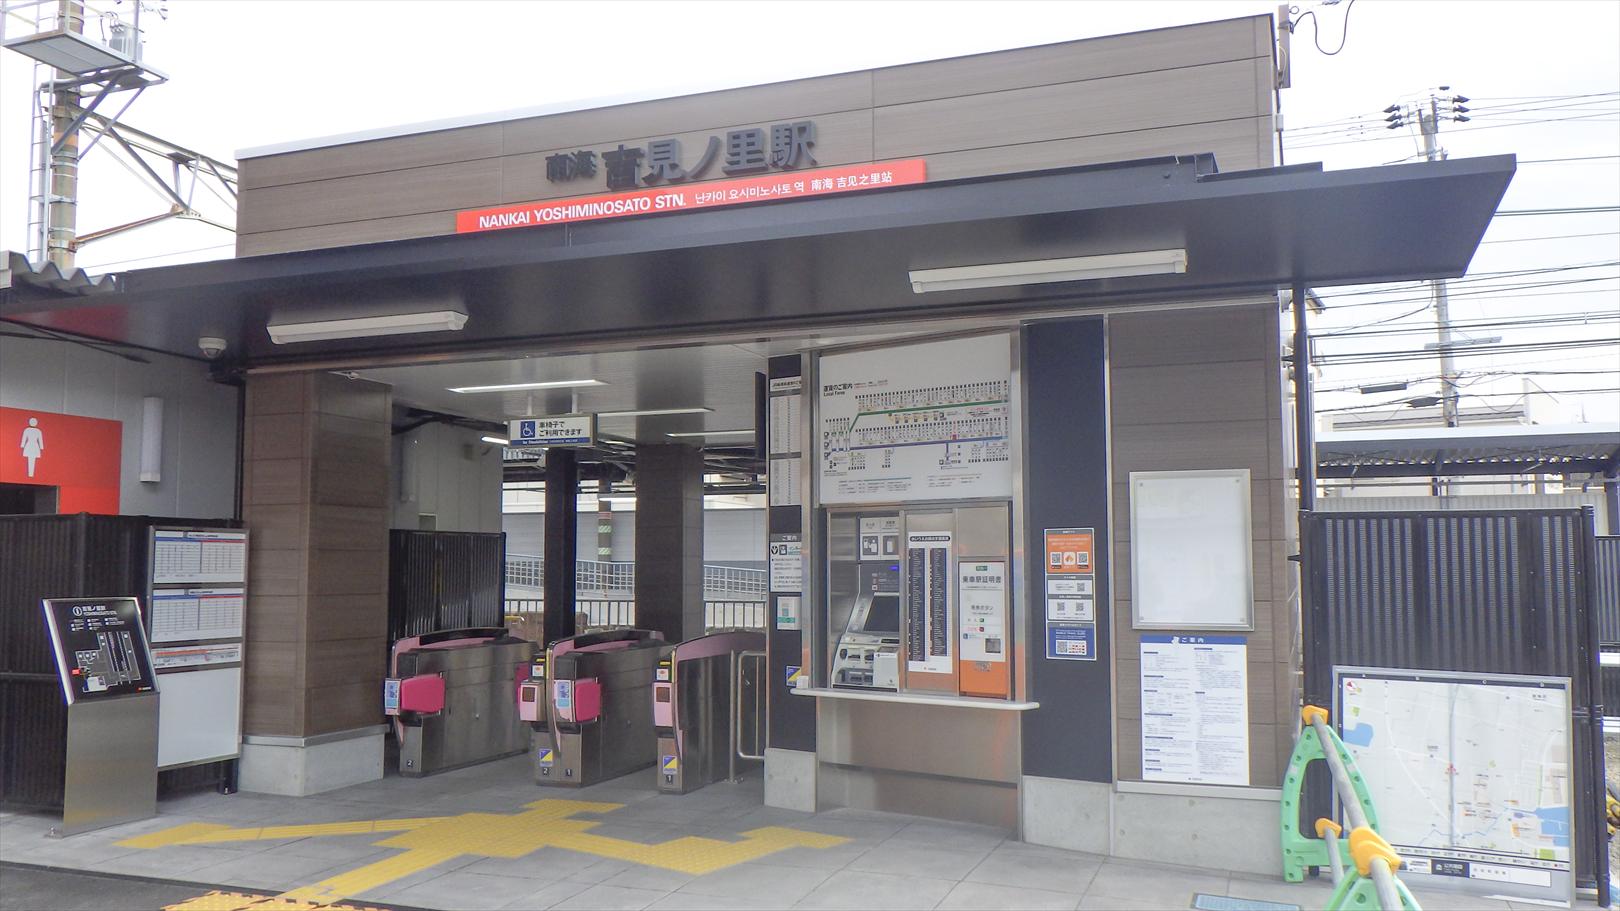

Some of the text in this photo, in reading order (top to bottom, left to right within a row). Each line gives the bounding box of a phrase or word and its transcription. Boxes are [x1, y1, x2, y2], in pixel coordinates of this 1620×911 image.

[545, 120, 817, 191] 南海 吉見ノ里駅
[695, 181, 804, 204] 난카이 요시미노사토 역
[811, 171, 893, 190] 南海 吉见之里站
[479, 194, 686, 228] NANKAI YOSHIMINOSATO STN.
